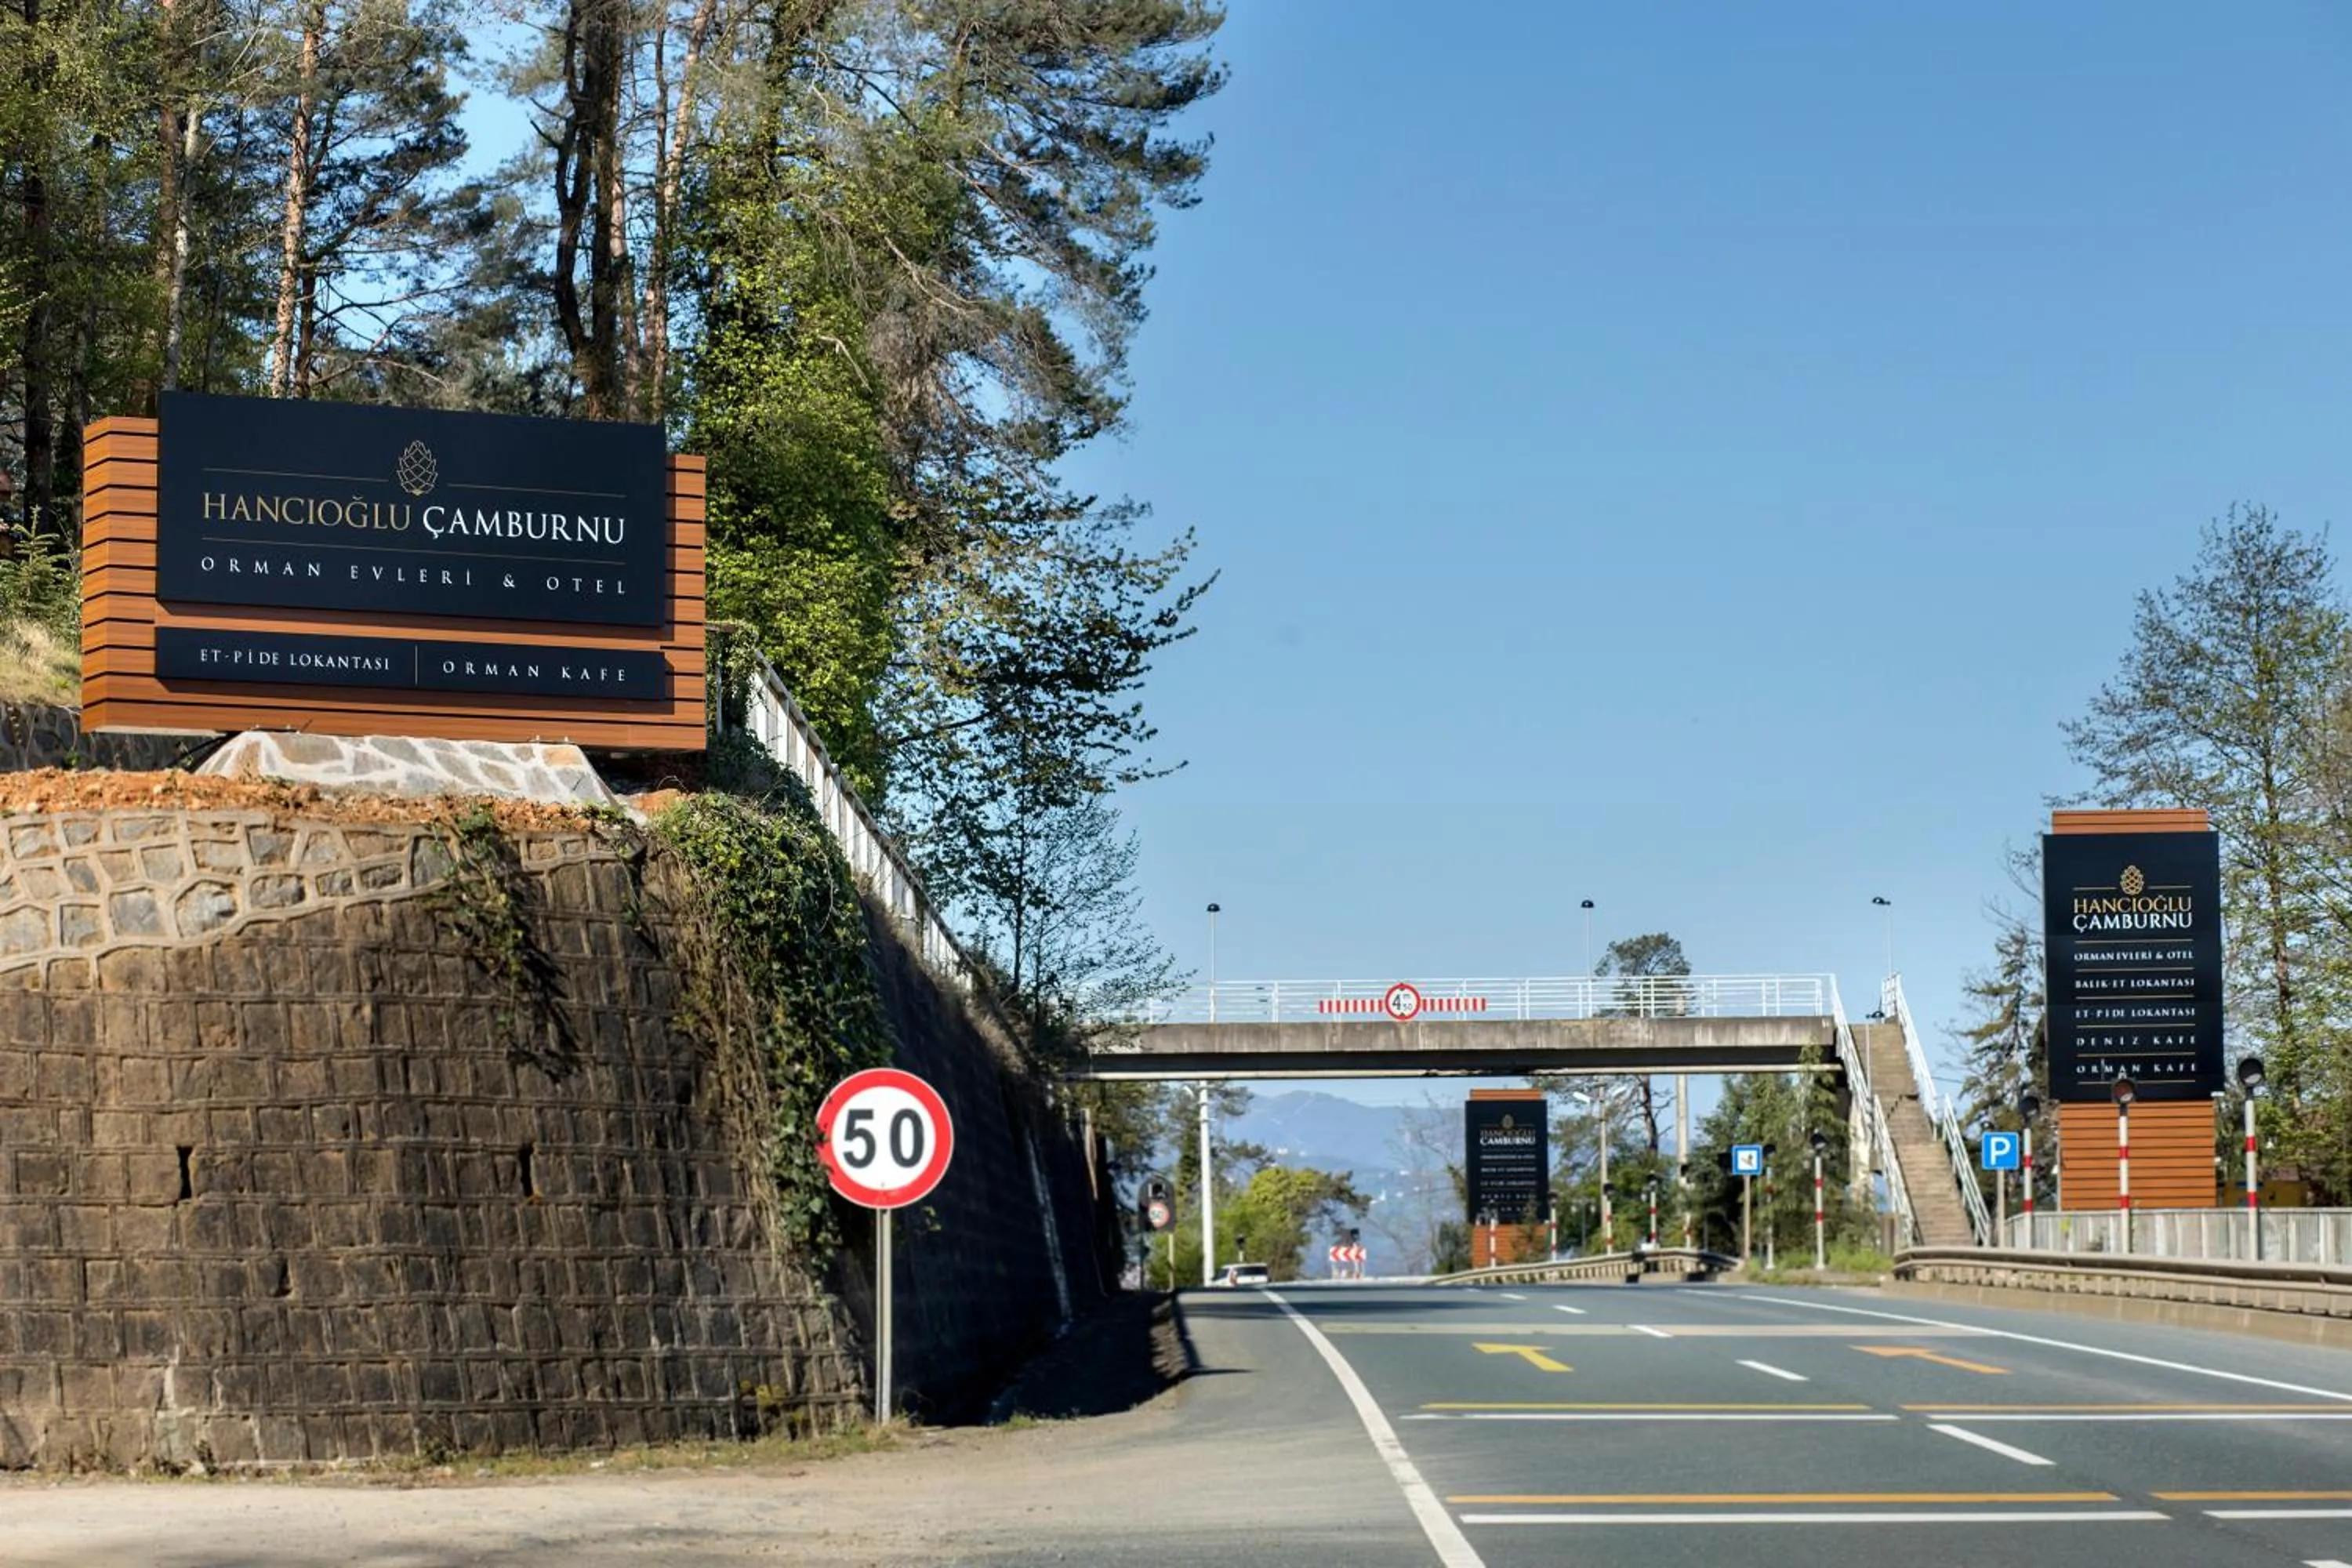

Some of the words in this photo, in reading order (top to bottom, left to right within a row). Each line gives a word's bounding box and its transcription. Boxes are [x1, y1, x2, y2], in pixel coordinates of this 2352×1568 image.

[202, 492, 412, 532] HANCIOĞLU
[422, 505, 626, 545] ÇAMBURNU
[201, 556, 321, 577] ORMAN
[503, 573, 516, 588] &
[546, 576, 626, 595] OTEL
[289, 652, 390, 671] LOKANTASI
[443, 660, 540, 678] ORMAN
[561, 666, 626, 682] KAFE
[2073, 895, 2192, 915] HANCIOĞLU
[2072, 912, 2193, 933] ÇAMBURNU
[2074, 951, 2114, 962] ORMAN
[2155, 950, 2164, 960] &
[2166, 949, 2194, 960] OTEL
[2130, 978, 2195, 989] LOKANTASI
[2131, 1007, 2196, 1018] LOKANTASI
[2152, 1035, 2196, 1045] KAFE
[2076, 1063, 2141, 1073] ORMAN
[2153, 1062, 2197, 1073] KAFE
[842, 1107, 925, 1169] 50
[1990, 1136, 2012, 1167] P
